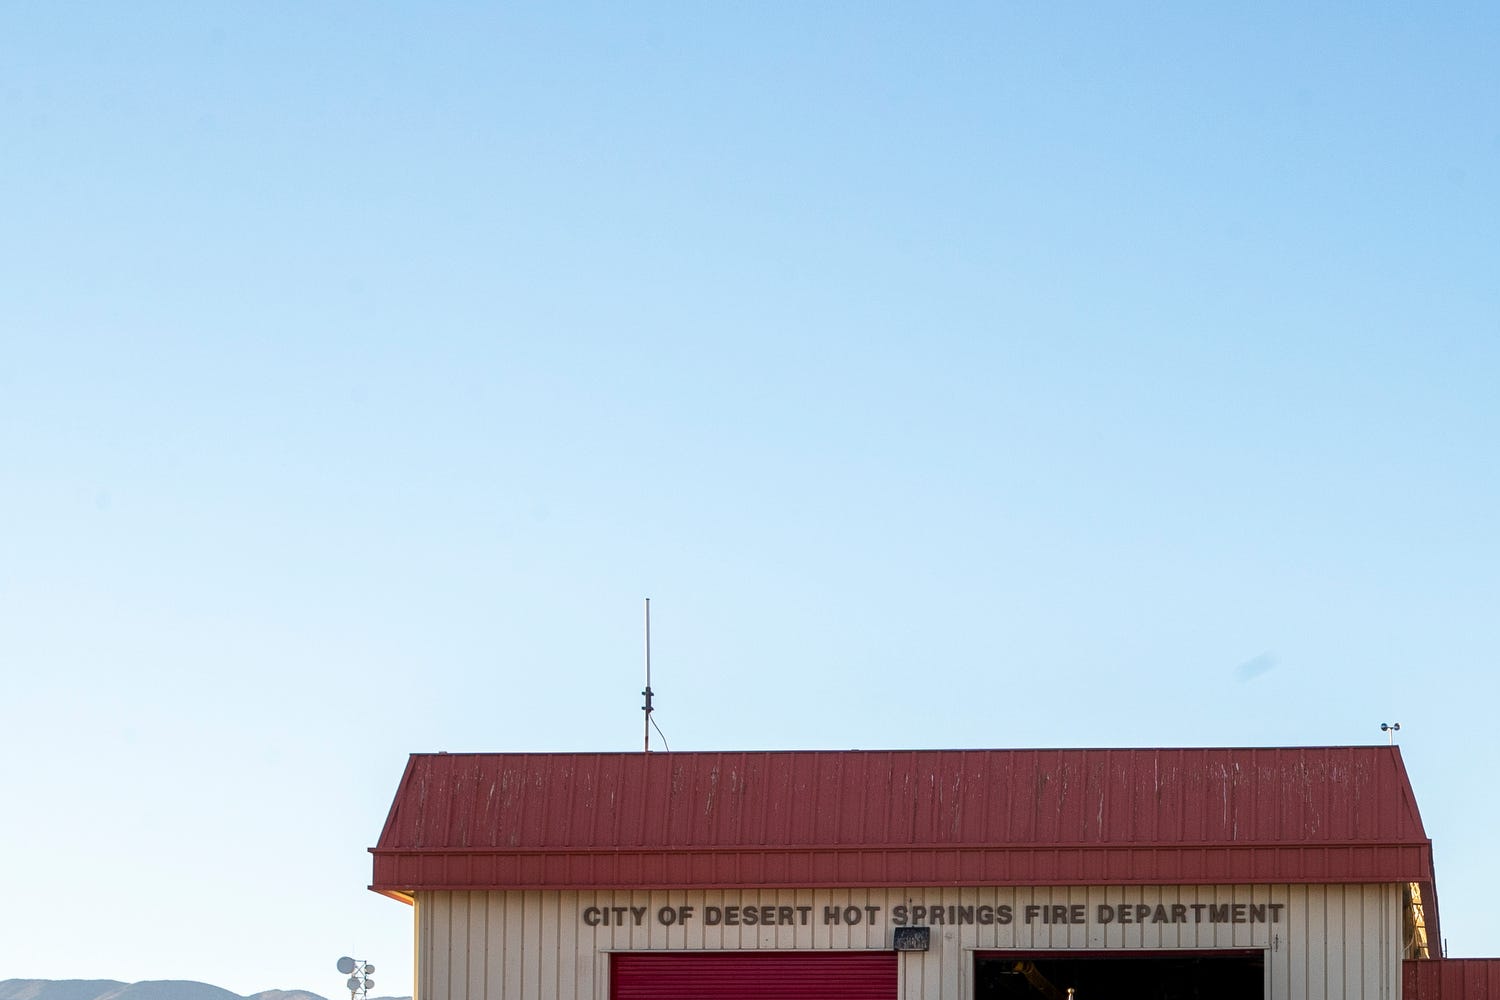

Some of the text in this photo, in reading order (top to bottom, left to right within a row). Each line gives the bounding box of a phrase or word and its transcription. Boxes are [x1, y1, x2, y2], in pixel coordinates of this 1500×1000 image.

[583, 903, 1284, 926] CITY OF DESERT HOT SPRINGS FIRE DEPARTMENT
